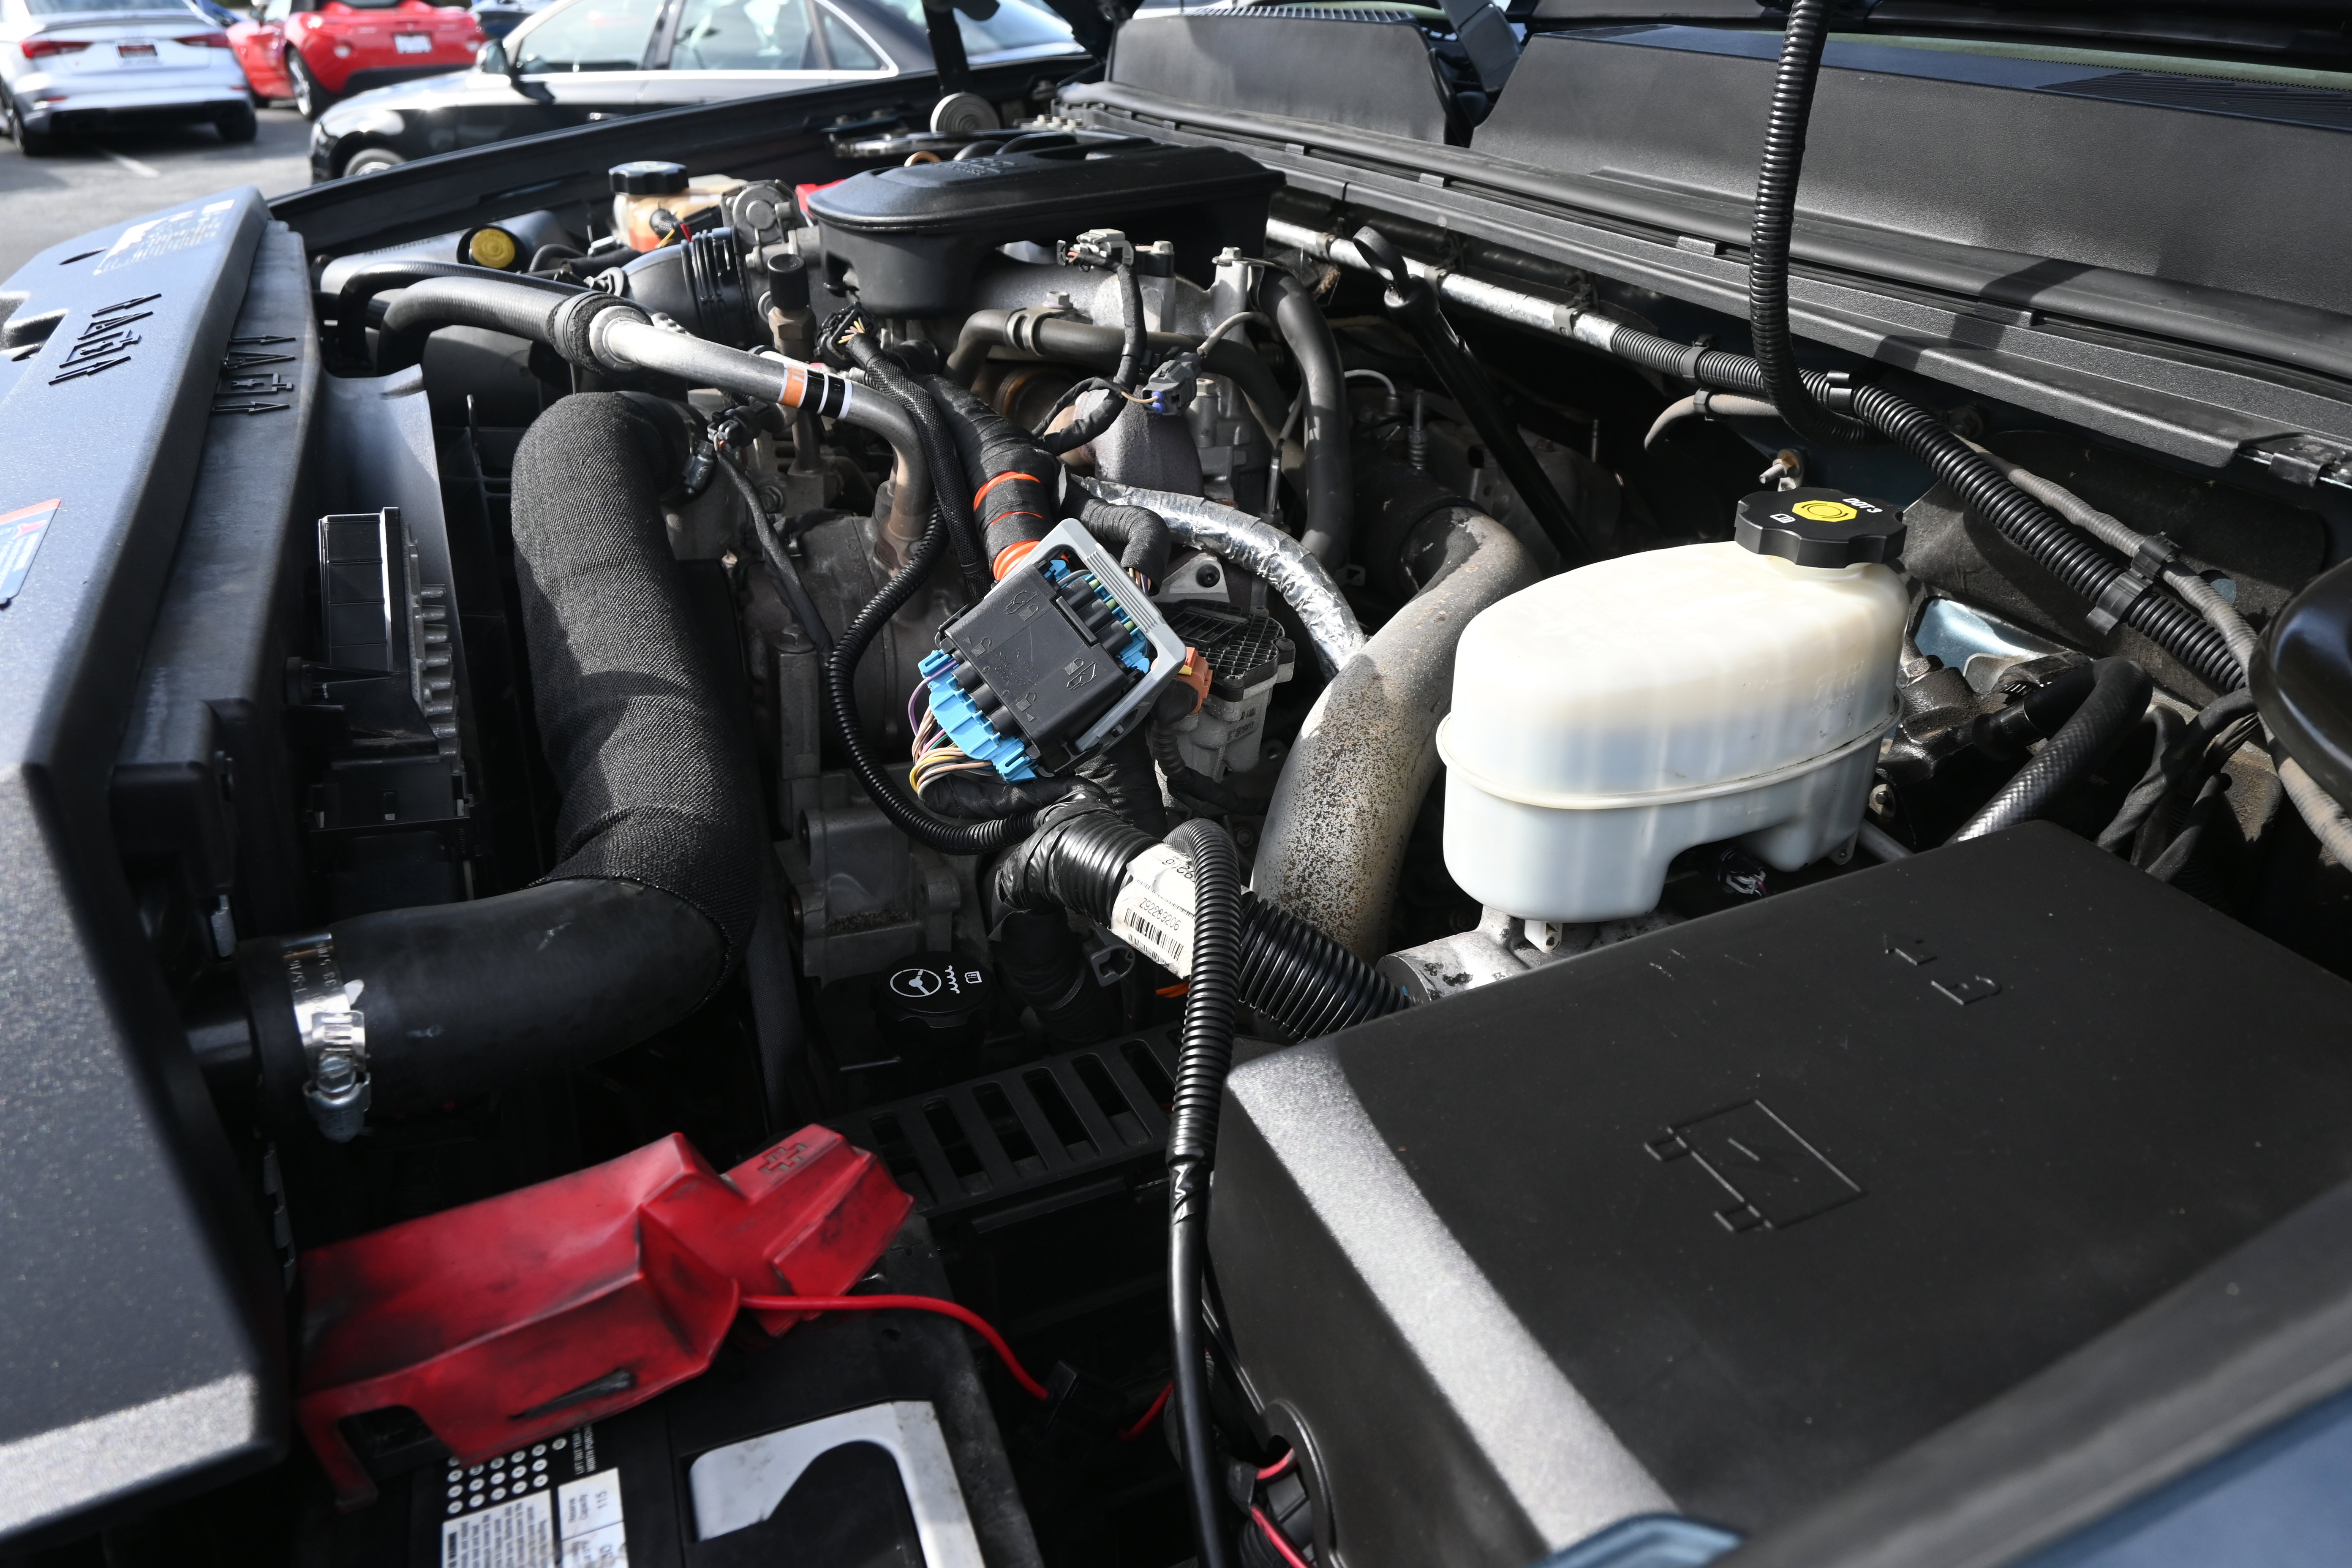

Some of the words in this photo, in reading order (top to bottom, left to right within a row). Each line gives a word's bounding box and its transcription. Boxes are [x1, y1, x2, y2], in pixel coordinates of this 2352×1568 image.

[1842, 498, 1876, 509] DOT
[572, 1433, 582, 1448] YEAR
[574, 1449, 583, 1461] OUT
[586, 1450, 596, 1472] MONTH
[574, 1461, 585, 1475] LIFT
[596, 1491, 609, 1509] 115
